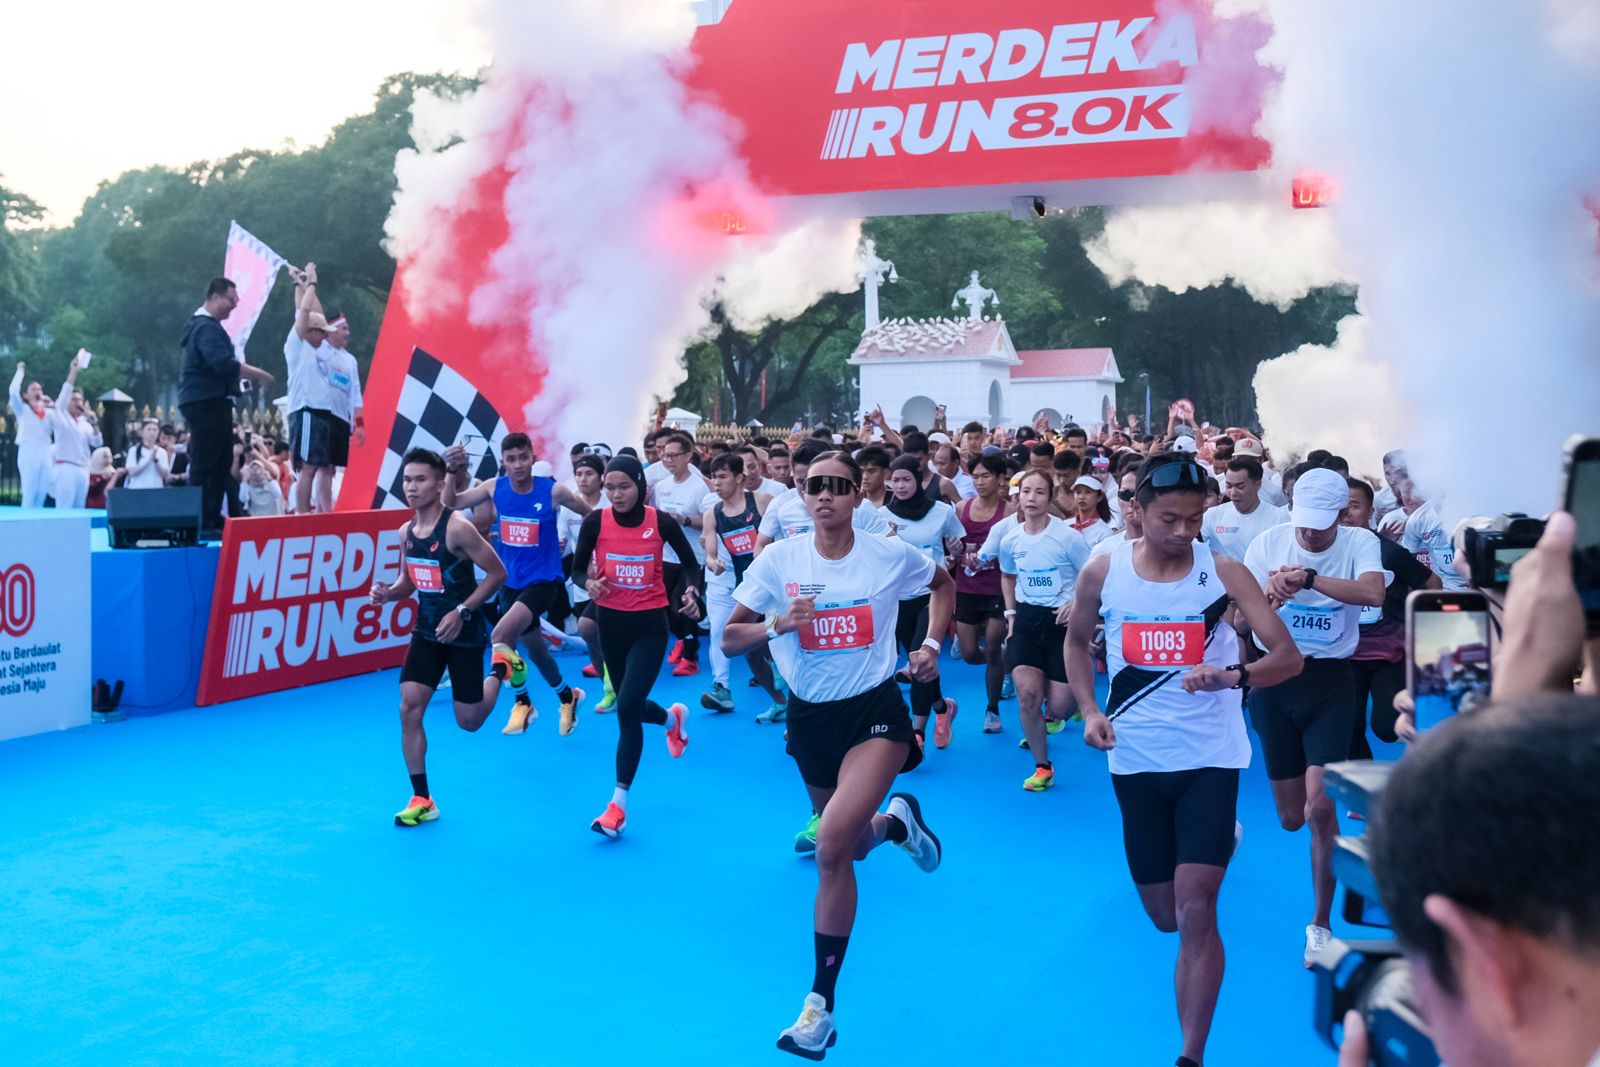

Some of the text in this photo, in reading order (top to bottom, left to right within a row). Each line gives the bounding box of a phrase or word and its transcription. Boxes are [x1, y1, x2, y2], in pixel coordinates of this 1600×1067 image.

[835, 13, 1199, 94] MERDEKA
[849, 99, 998, 158] RUN
[509, 525, 529, 537] 11742
[233, 529, 401, 605] MERDE
[615, 564, 645, 578] 12083
[1027, 576, 1053, 587] 21686
[812, 615, 857, 636] 10733
[1292, 615, 1332, 631] 21445
[245, 597, 418, 677] RUN 8.0
[1139, 630, 1186, 651] 11083
[14, 642, 61, 660] Berdaulat
[9, 661, 56, 679] Sejahtera
[0, 677, 46, 696] esia Maju
